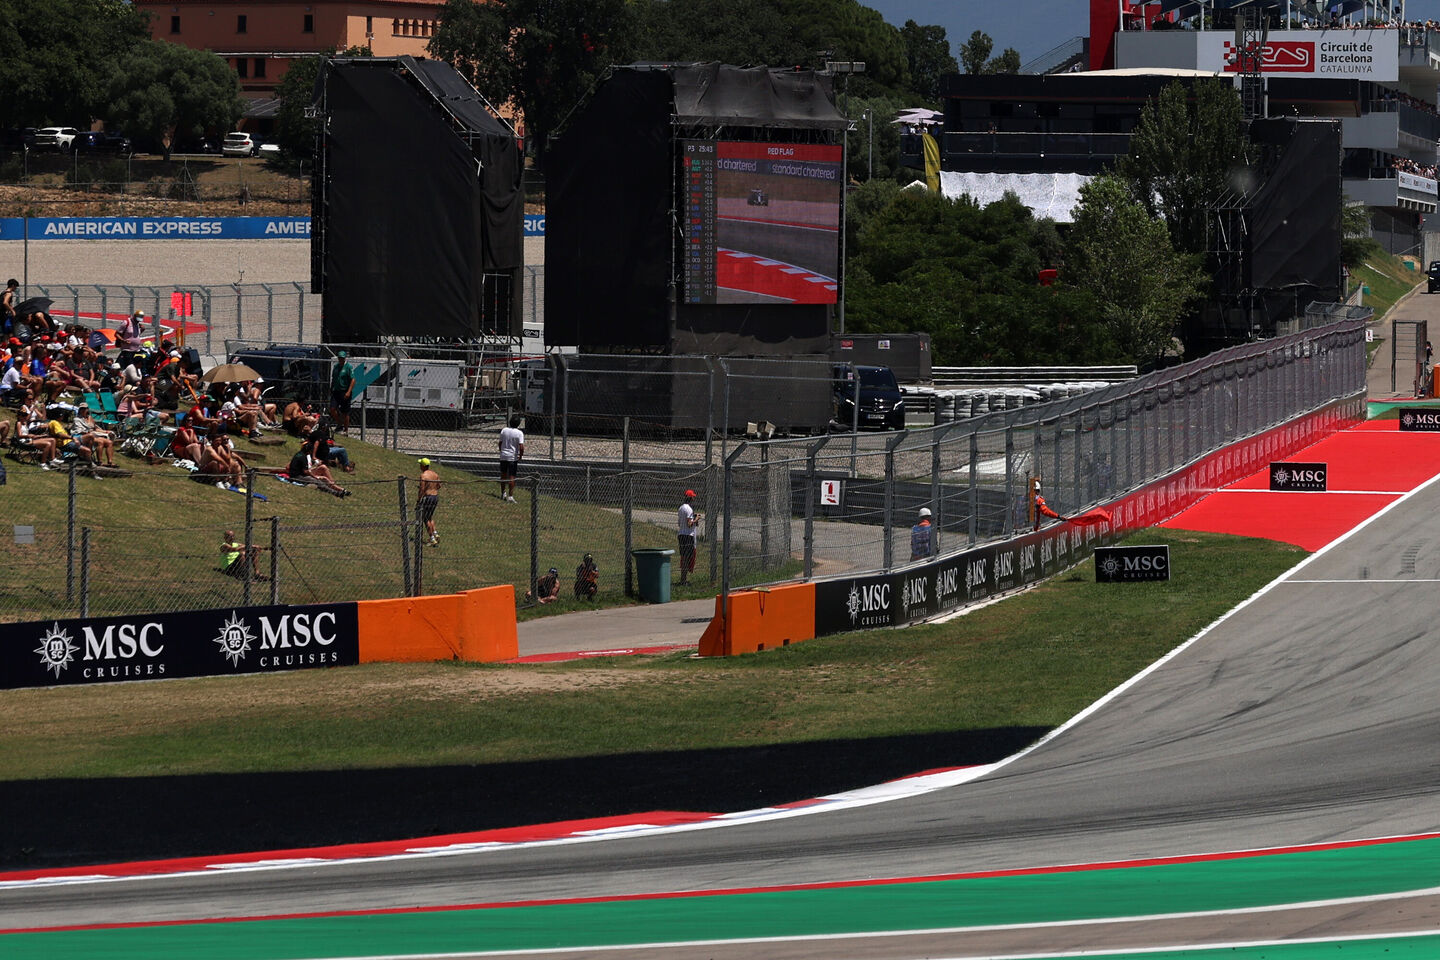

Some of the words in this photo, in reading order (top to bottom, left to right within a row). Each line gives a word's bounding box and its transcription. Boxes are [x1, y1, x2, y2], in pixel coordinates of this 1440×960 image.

[1320, 42, 1357, 52] Circuit
[1361, 42, 1373, 52] de
[1320, 54, 1373, 63] Barcelona
[1320, 65, 1373, 73] CATALUNYA
[779, 148, 794, 156] FLAG
[723, 158, 757, 172] chartered
[771, 163, 802, 176] standard
[802, 166, 835, 180] chartered
[44, 221, 137, 235] AMERICAN
[143, 221, 222, 235] EXPRESS
[1291, 470, 1325, 482] MSC
[1000, 551, 1014, 577] MSC
[1123, 555, 1166, 571] MSC
[972, 558, 987, 586] MSC
[943, 567, 958, 596] MSC
[862, 583, 890, 612] MSC
[910, 576, 928, 605] MSC
[861, 615, 890, 626] CRUISES
[258, 612, 337, 650] MSC
[82, 622, 164, 661] MSC
[260, 652, 338, 667] CRUISES
[83, 663, 165, 678] CRUISES
